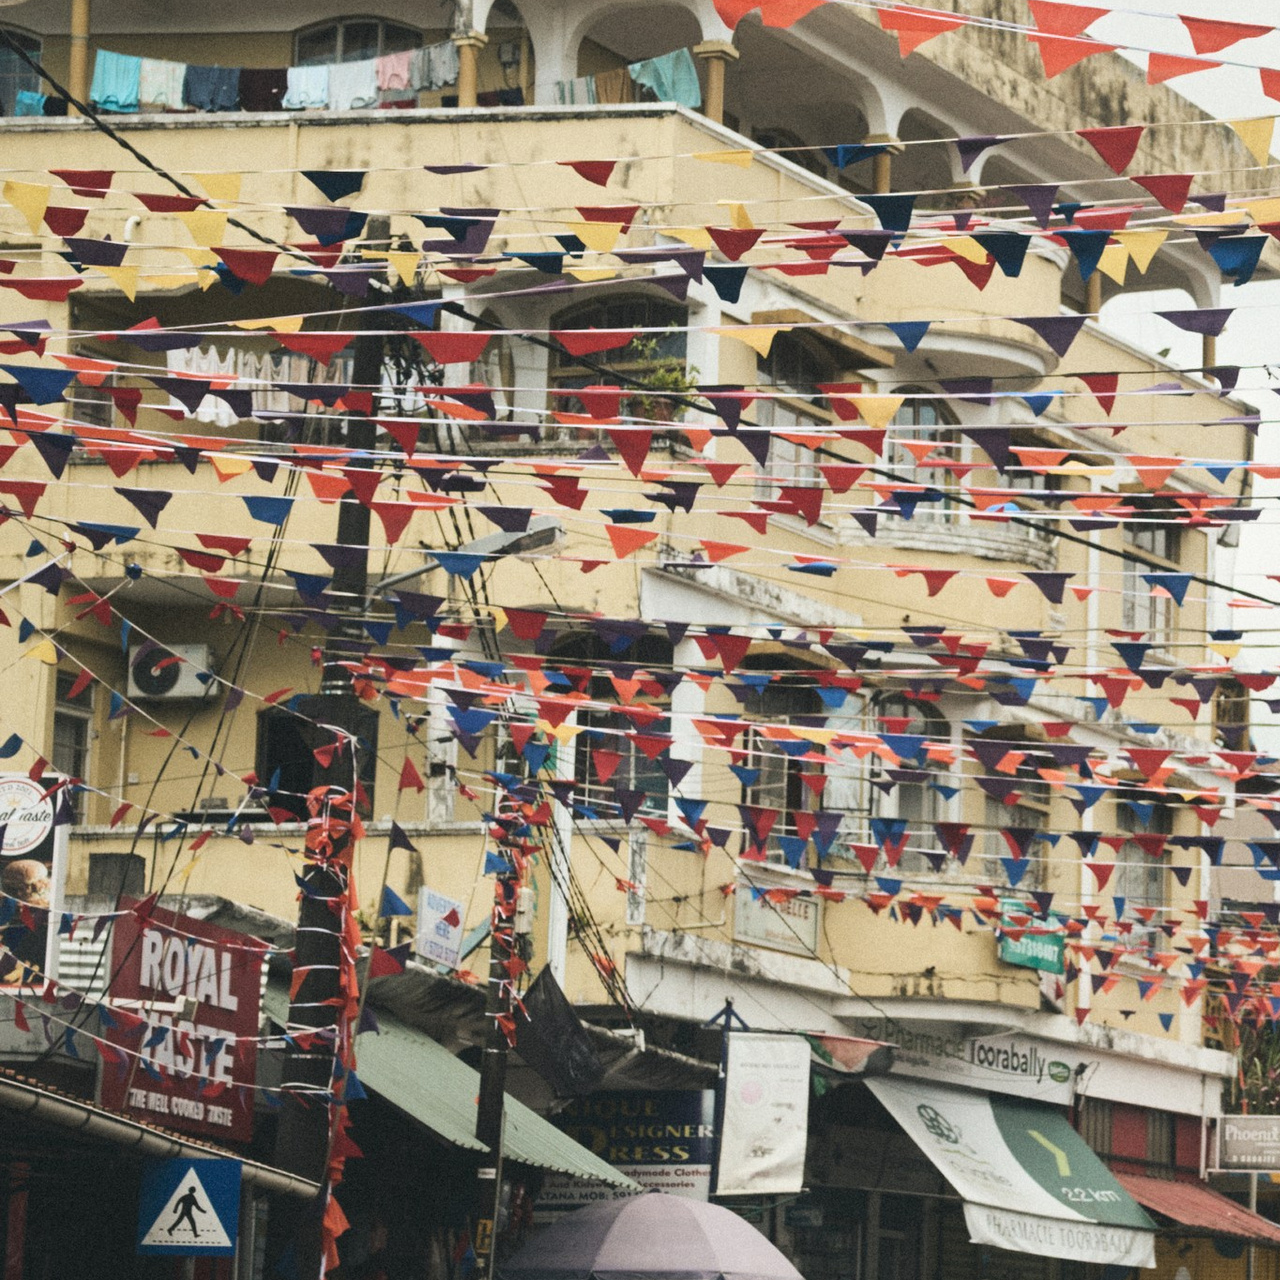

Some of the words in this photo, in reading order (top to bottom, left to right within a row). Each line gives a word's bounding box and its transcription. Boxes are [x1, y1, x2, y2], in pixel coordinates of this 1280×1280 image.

[139, 927, 239, 1011] ROYAL
[138, 1007, 237, 1089] TASTE
[885, 1018, 966, 1060] Pharmacie
[970, 1038, 1047, 1084] Toorabally
[129, 1088, 147, 1110] THE
[150, 1093, 170, 1114] WELL
[170, 1097, 204, 1122] COOKED
[207, 1104, 233, 1128] TASTE
[1225, 1124, 1279, 1141] Phoenix
[1061, 1186, 1092, 1203] 22
[1092, 1187, 1122, 1203] km
